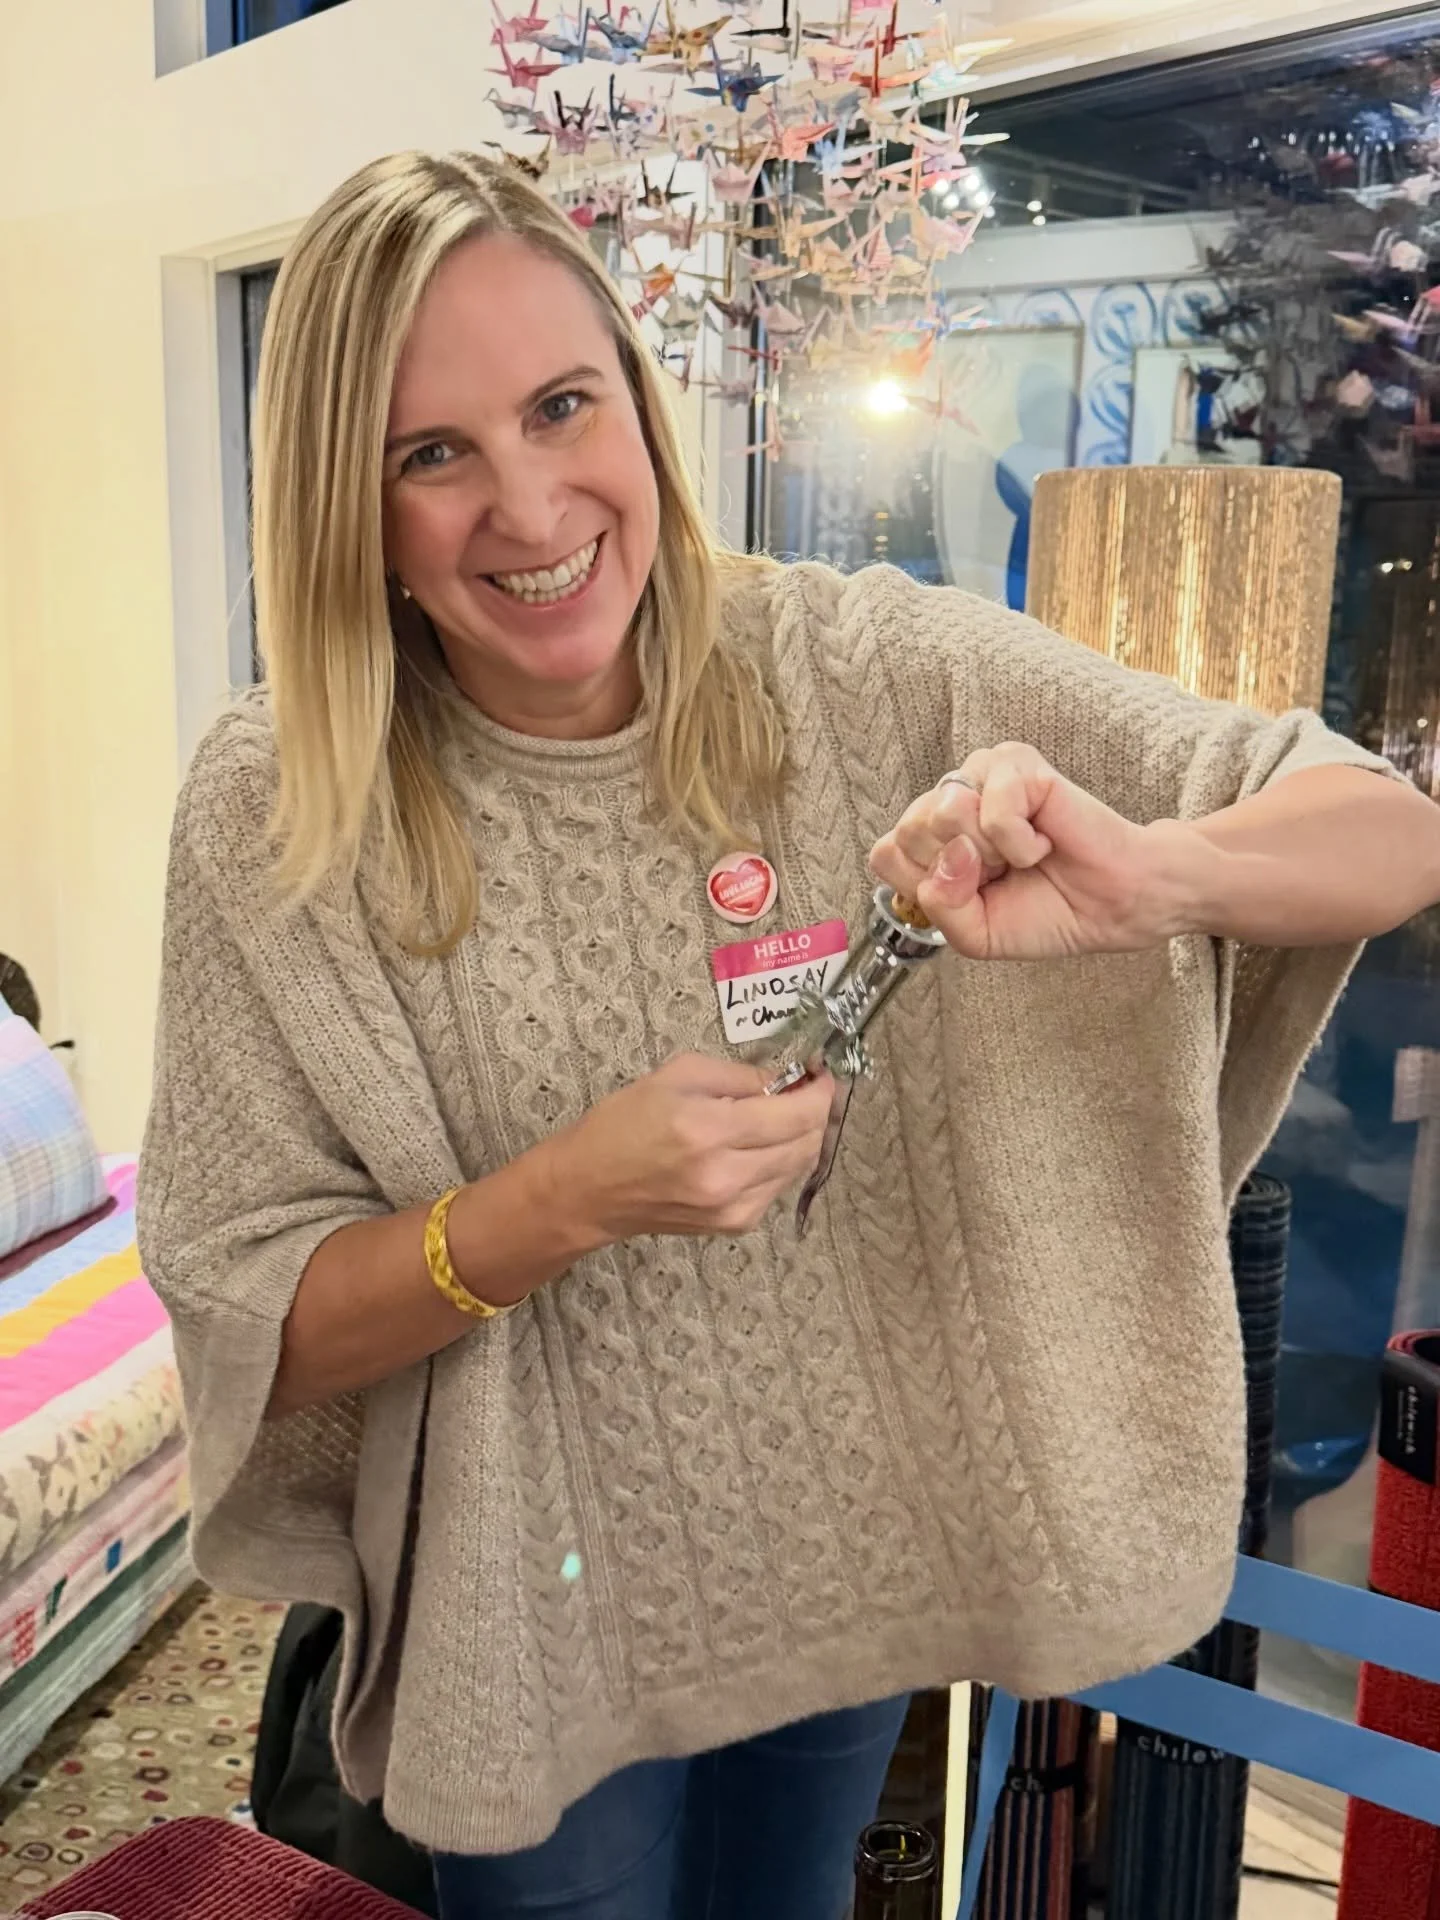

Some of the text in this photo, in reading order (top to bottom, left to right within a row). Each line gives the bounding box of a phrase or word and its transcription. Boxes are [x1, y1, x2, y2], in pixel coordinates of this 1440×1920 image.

[753, 934, 811, 960] HELLO
[761, 951, 809, 969] my name is
